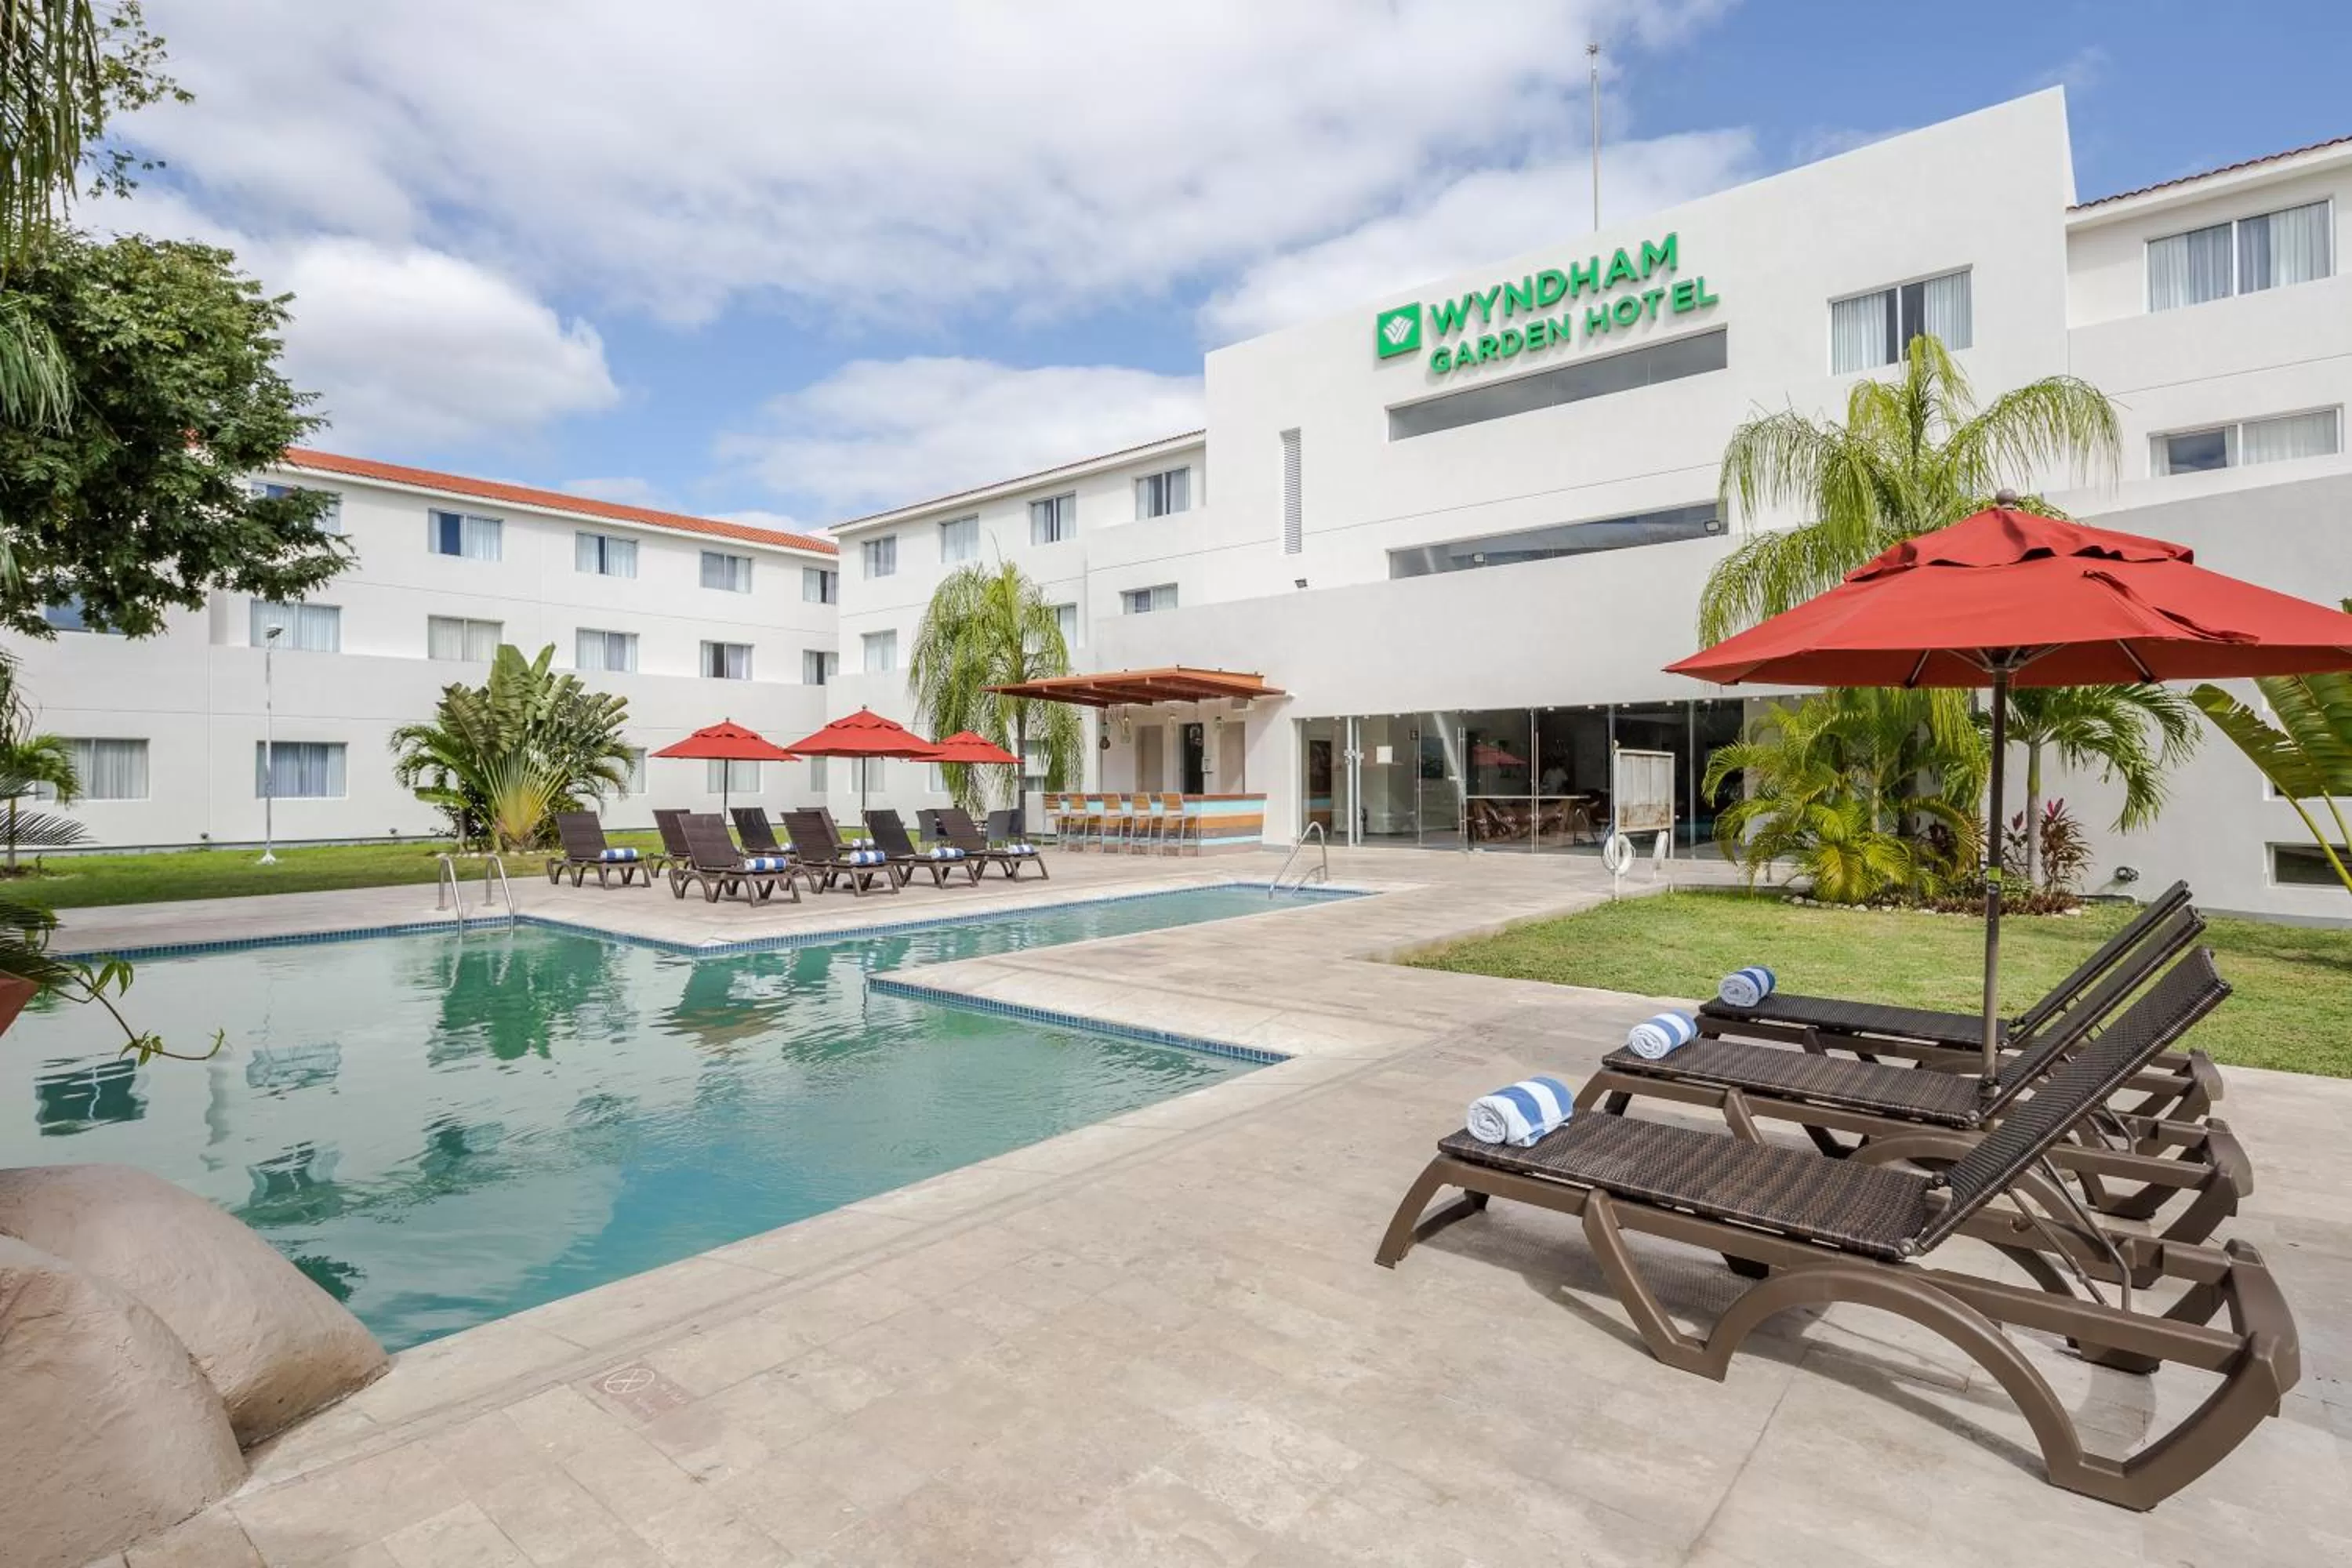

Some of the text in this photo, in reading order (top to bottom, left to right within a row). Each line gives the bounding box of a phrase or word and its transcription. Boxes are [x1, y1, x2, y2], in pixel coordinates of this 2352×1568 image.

[1429, 276, 1719, 374] GARDEN HOTEL
[1430, 233, 1678, 336] WYNDHAM
